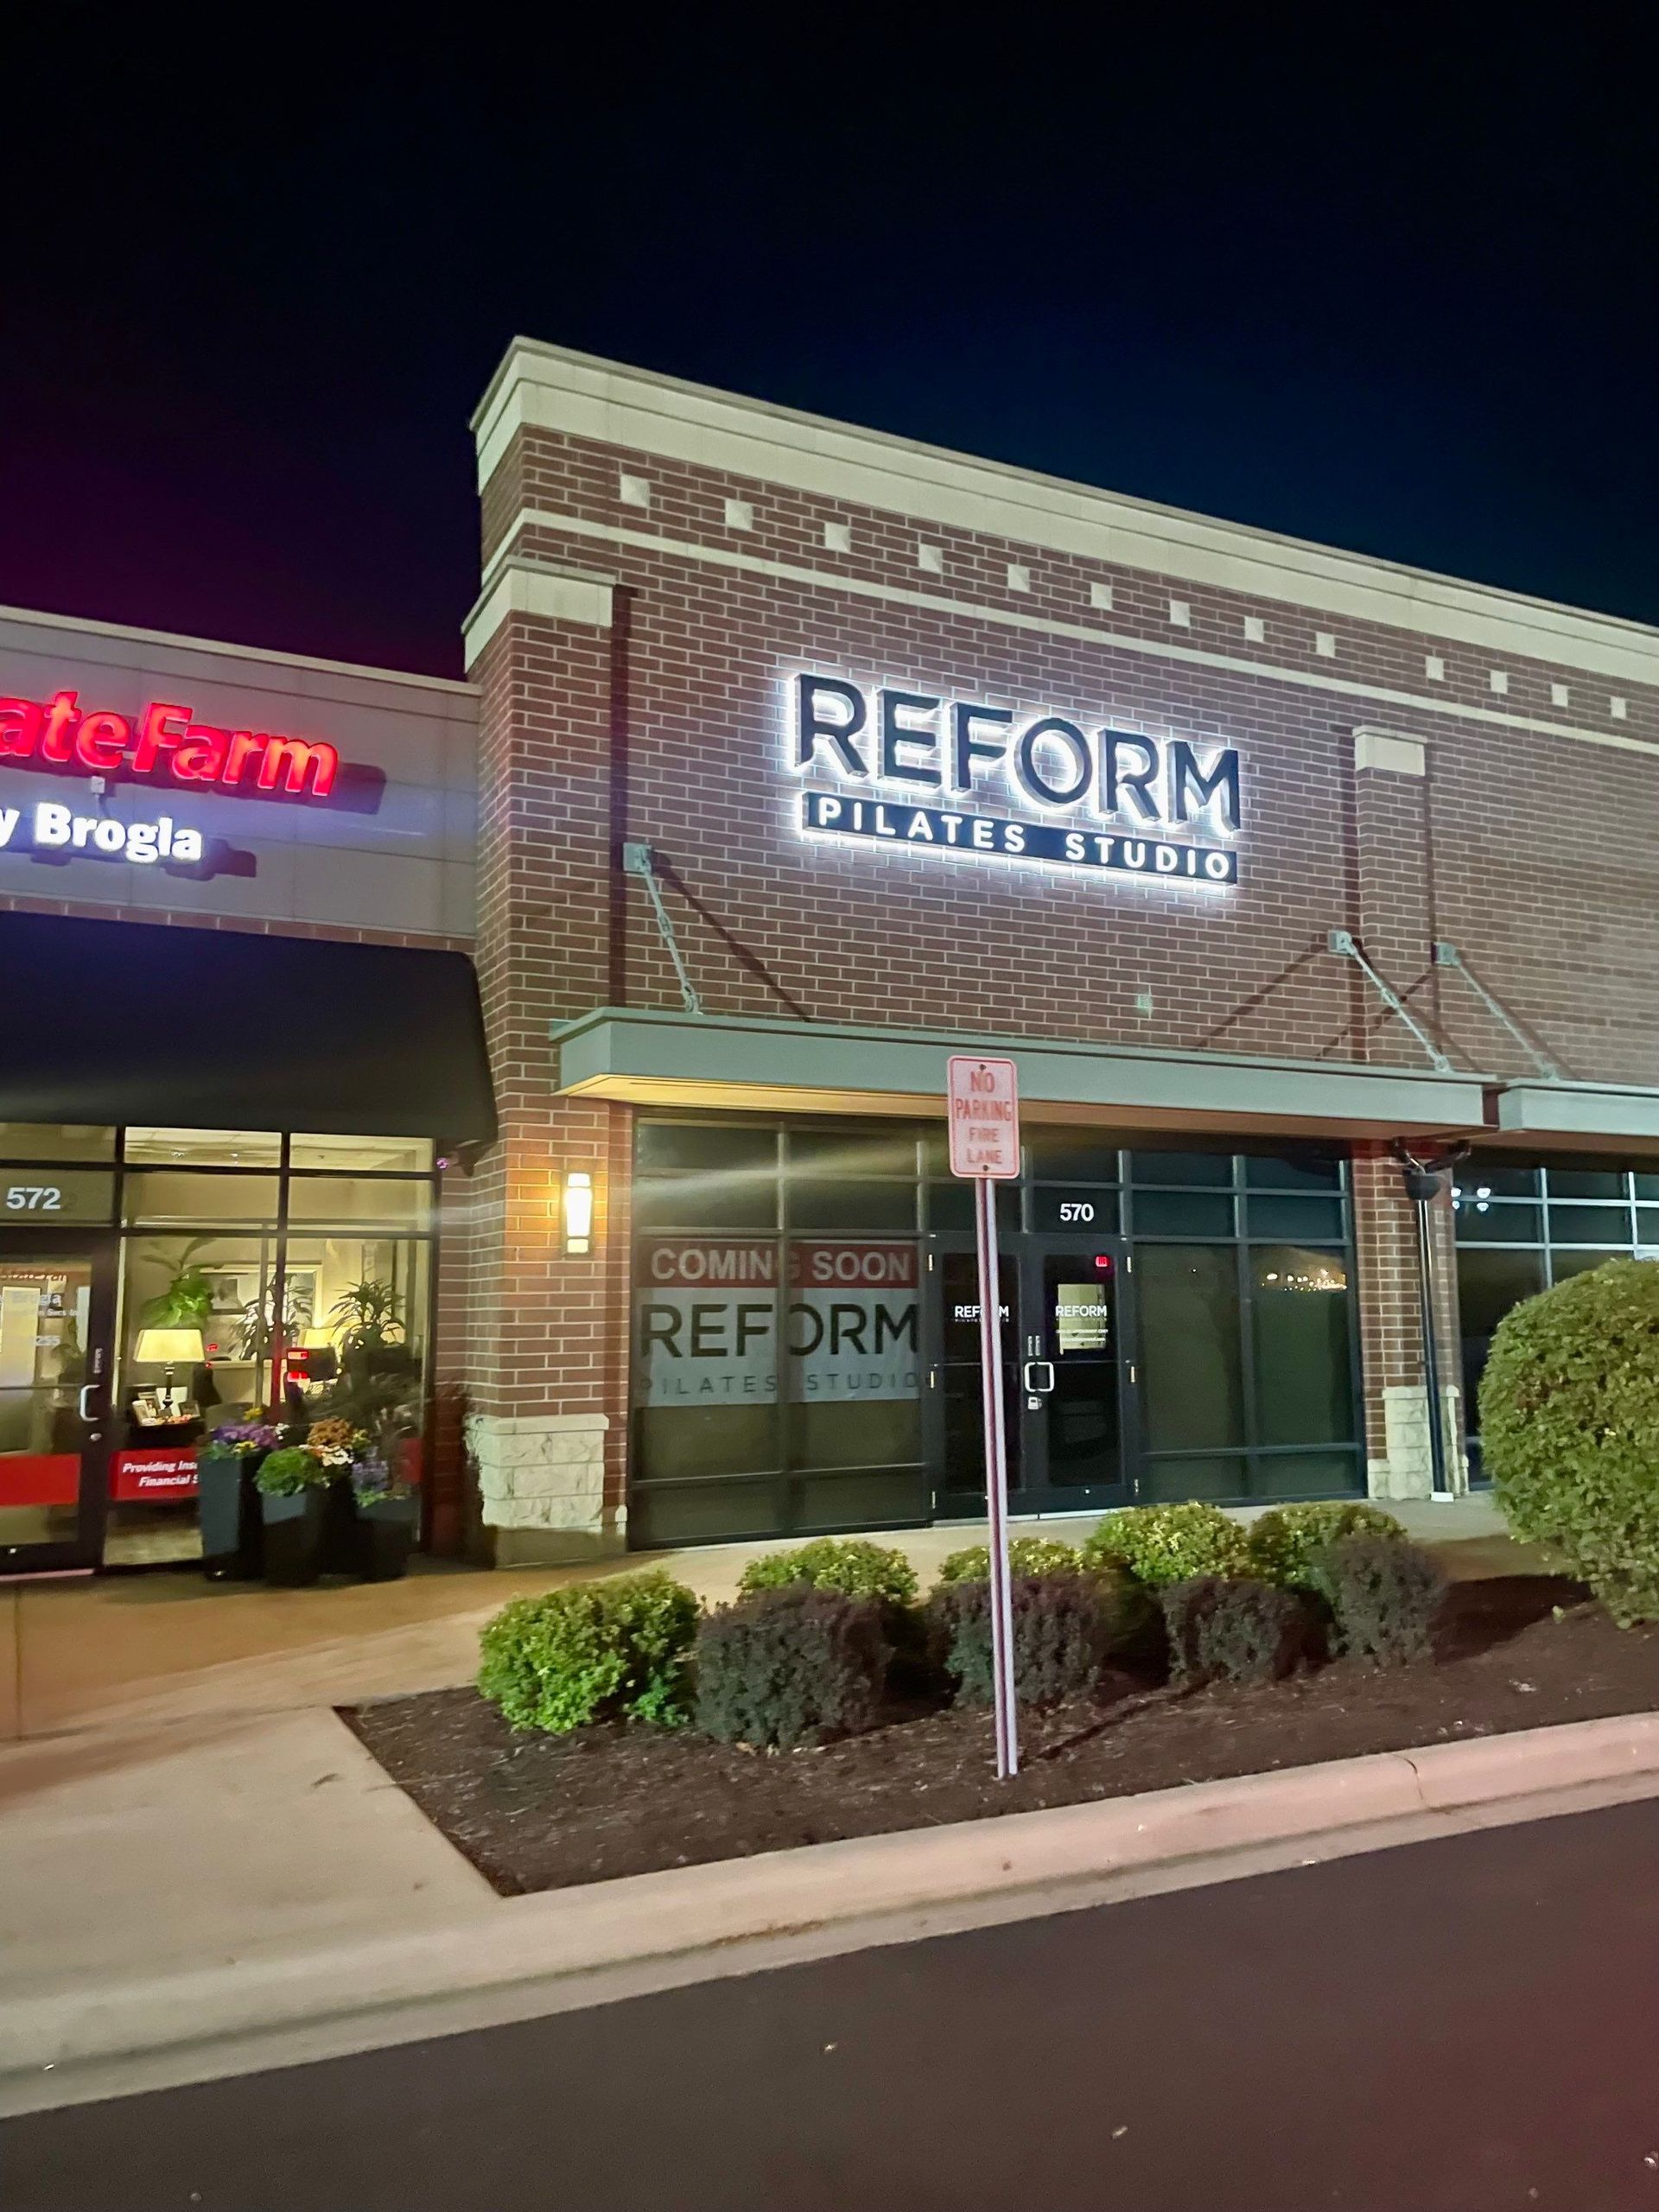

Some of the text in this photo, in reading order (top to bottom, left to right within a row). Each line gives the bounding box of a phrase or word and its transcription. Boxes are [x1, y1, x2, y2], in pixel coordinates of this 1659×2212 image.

[794, 673, 1241, 837] REFORM
[35, 801, 202, 862] Brogla
[818, 796, 1230, 880] PILATES STUDIO
[970, 1071, 995, 1093] NO
[956, 1098, 1013, 1121] PARKING
[969, 1128, 1000, 1142] FIRE
[967, 1148, 1002, 1164] LANE
[7, 1187, 61, 1210] 572
[1059, 1203, 1095, 1222] 570
[811, 1250, 911, 1281] SOON
[955, 1306, 1009, 1318] REFM
[1055, 1305, 1107, 1318] REFORM
[640, 1303, 918, 1357] REFORM
[122, 1461, 176, 1473] Providing
[138, 1474, 191, 1486] Financial
